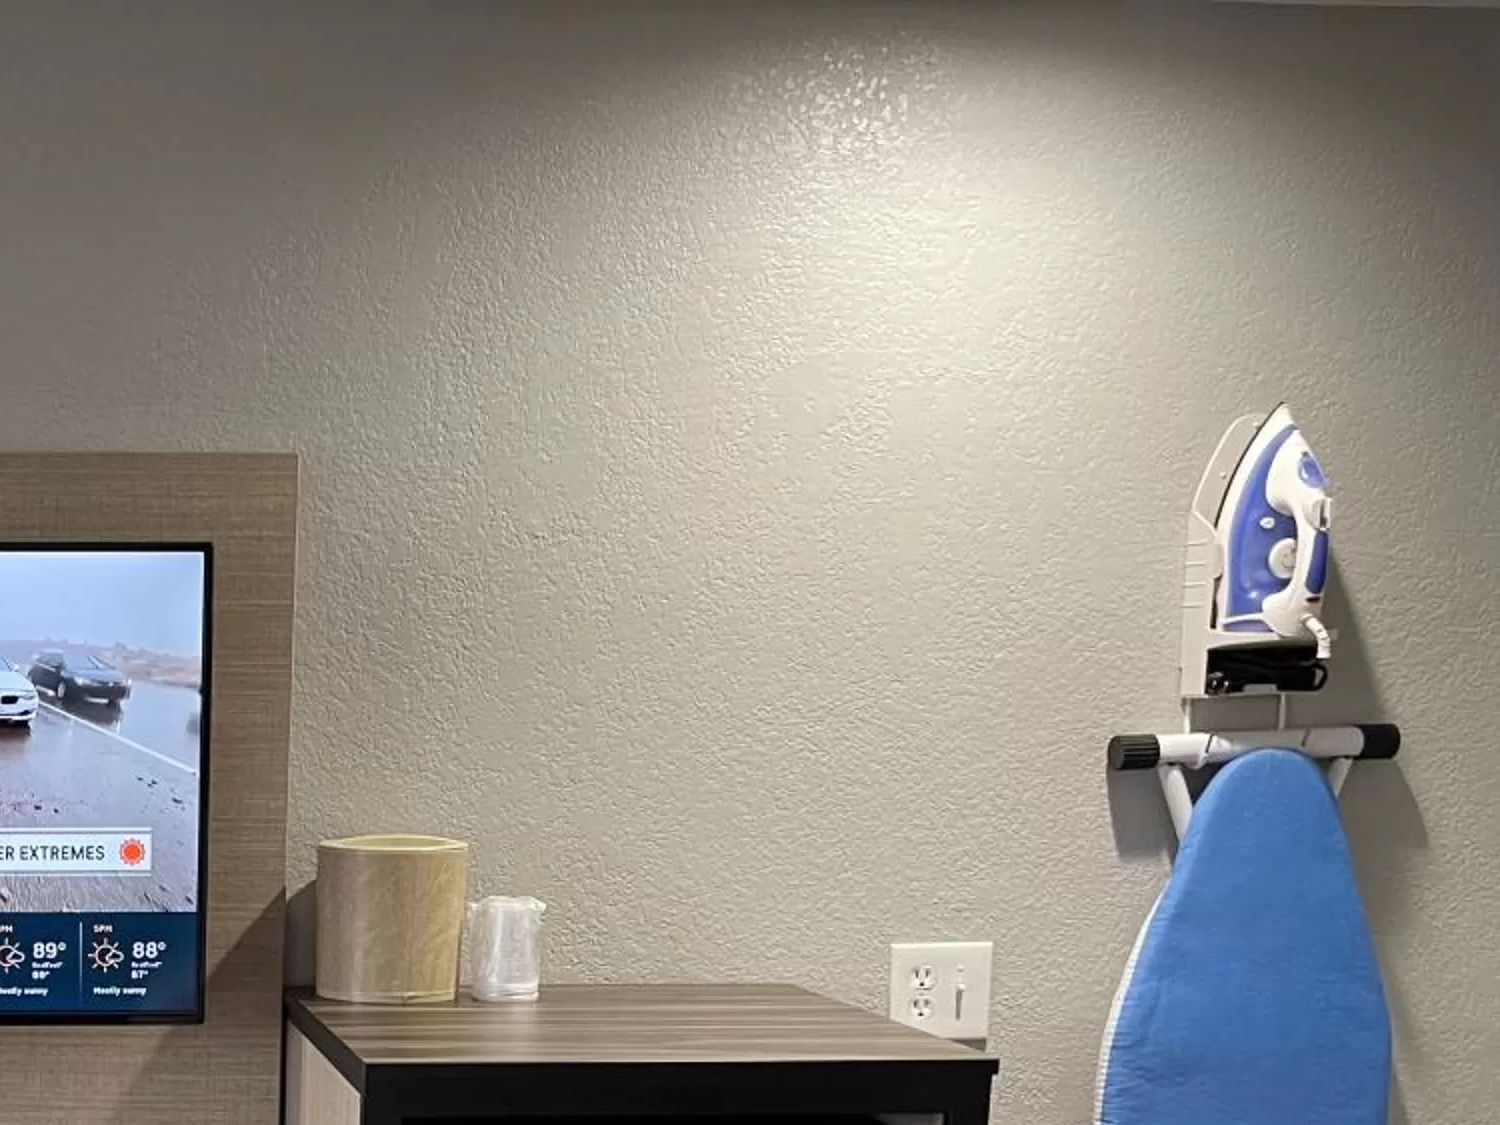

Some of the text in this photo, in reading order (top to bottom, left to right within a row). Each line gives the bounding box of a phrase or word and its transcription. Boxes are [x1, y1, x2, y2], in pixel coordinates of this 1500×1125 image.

[19, 845, 105, 860] EXTREMES
[32, 941, 67, 959] 89°
[131, 941, 167, 959] 88°
